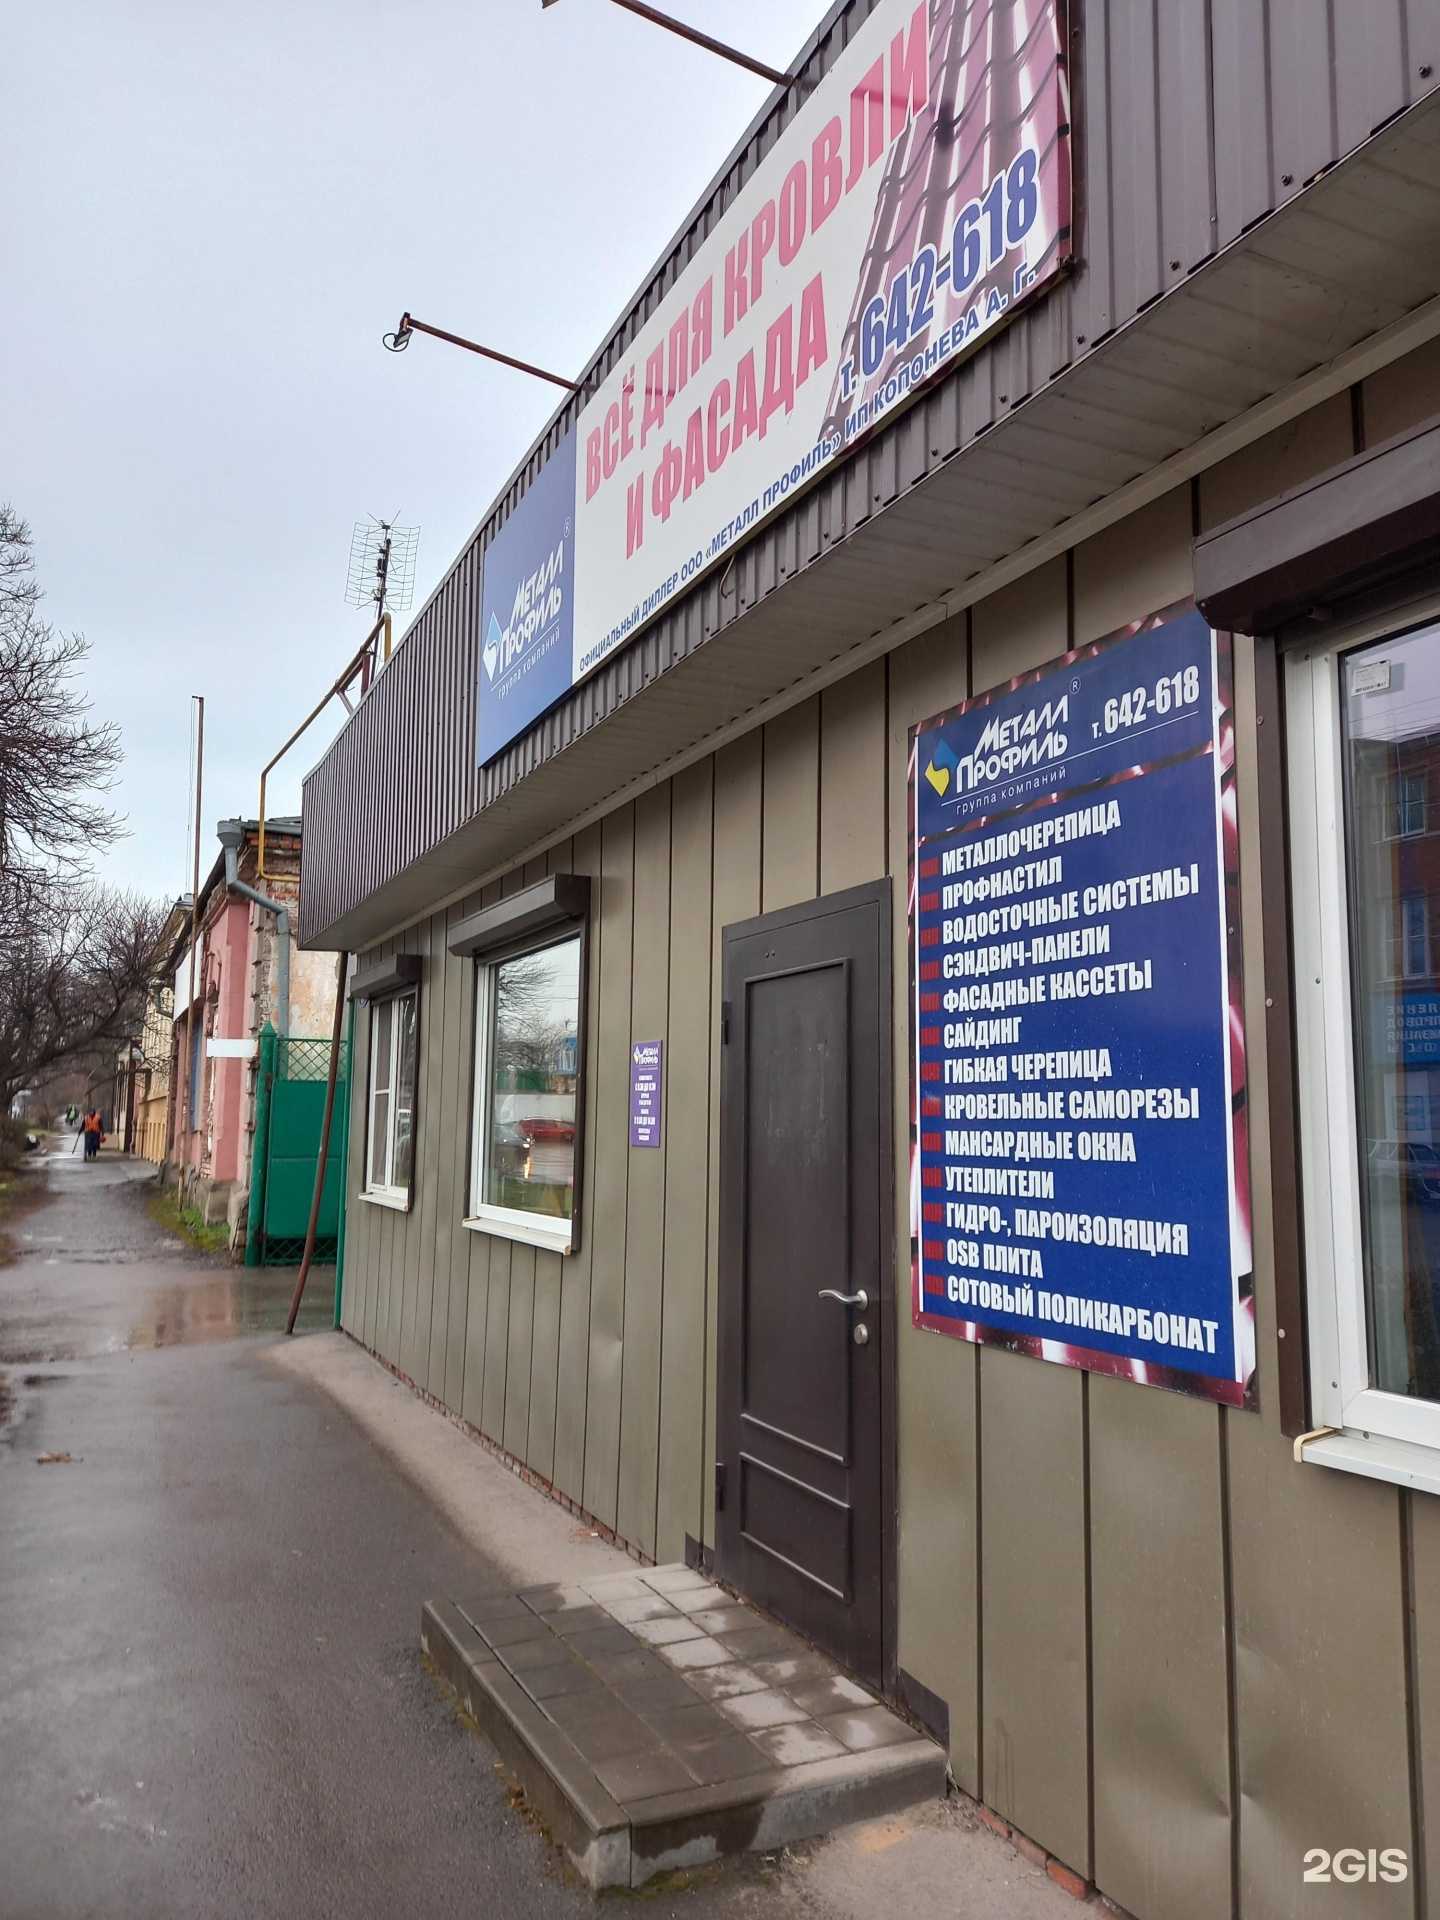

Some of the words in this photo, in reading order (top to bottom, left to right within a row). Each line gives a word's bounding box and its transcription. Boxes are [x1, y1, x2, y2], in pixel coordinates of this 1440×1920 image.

[586, 364, 635, 505] ВСЁ
[641, 274, 713, 450] ДЛЯ
[723, 1, 928, 339] КРОВЛИ
[862, 148, 1038, 377] 642-618
[626, 471, 644, 561] И
[652, 272, 828, 524] ФАСАДА
[579, 604, 640, 672] ОФИЦИАЛЬНЫЙ
[641, 572, 679, 620] ДИЛЛЕР
[681, 550, 703, 581] ООО
[705, 499, 759, 560] «МЕТАЛЛ
[763, 432, 842, 511] ПРОФИЛЬ»
[845, 406, 869, 437] ИП
[874, 308, 980, 411] КОПОНЕВА
[974, 694, 1069, 760] МЕТАЛЛ
[1104, 665, 1200, 734] 642-618
[956, 730, 1068, 793] ПРОФИЛЬ
[956, 793, 997, 816] группа
[1001, 765, 1067, 800] компаний
[942, 799, 1122, 876] МЕТАЛЛОЧЕРЕПИЦА
[942, 856, 1063, 910] ПРОФНАСТИЛ
[942, 891, 1079, 945] ВОДОСТОЧНЫЕ
[1083, 863, 1199, 916] СИСТЕМЫ
[943, 925, 1110, 979] СЭНДВИЧ-ПАНЕЛИ
[943, 974, 1046, 1013] ФАСАДНЫЕ
[1050, 960, 1152, 1000] КАССЕТЫ
[943, 1017, 1023, 1050] САЙДИНГ
[944, 1057, 1007, 1085] ГИБКАЯ
[1011, 1048, 1113, 1083] ЧЕРЕПИЦА
[944, 1092, 1065, 1121] КРОВЕЛЬНЫЕ
[1068, 1087, 1200, 1120] САМОРЕЗЫ
[945, 1130, 1074, 1162] МАНСАРДНЫЕ
[1077, 1131, 1137, 1163] ОКНА
[945, 1166, 1055, 1200] УТЕПЛИТЕЛИ
[946, 1202, 1012, 1237] ГИДРО-,
[1015, 1208, 1189, 1257] ПАРОИЗОЛЯЦИЯ
[946, 1239, 980, 1269] OSB
[983, 1243, 1044, 1280] ПЛИТА
[947, 1275, 1034, 1317] СОТОВЫЙ
[1038, 1292, 1219, 1355] ПОЛИКАРБОНАТ
